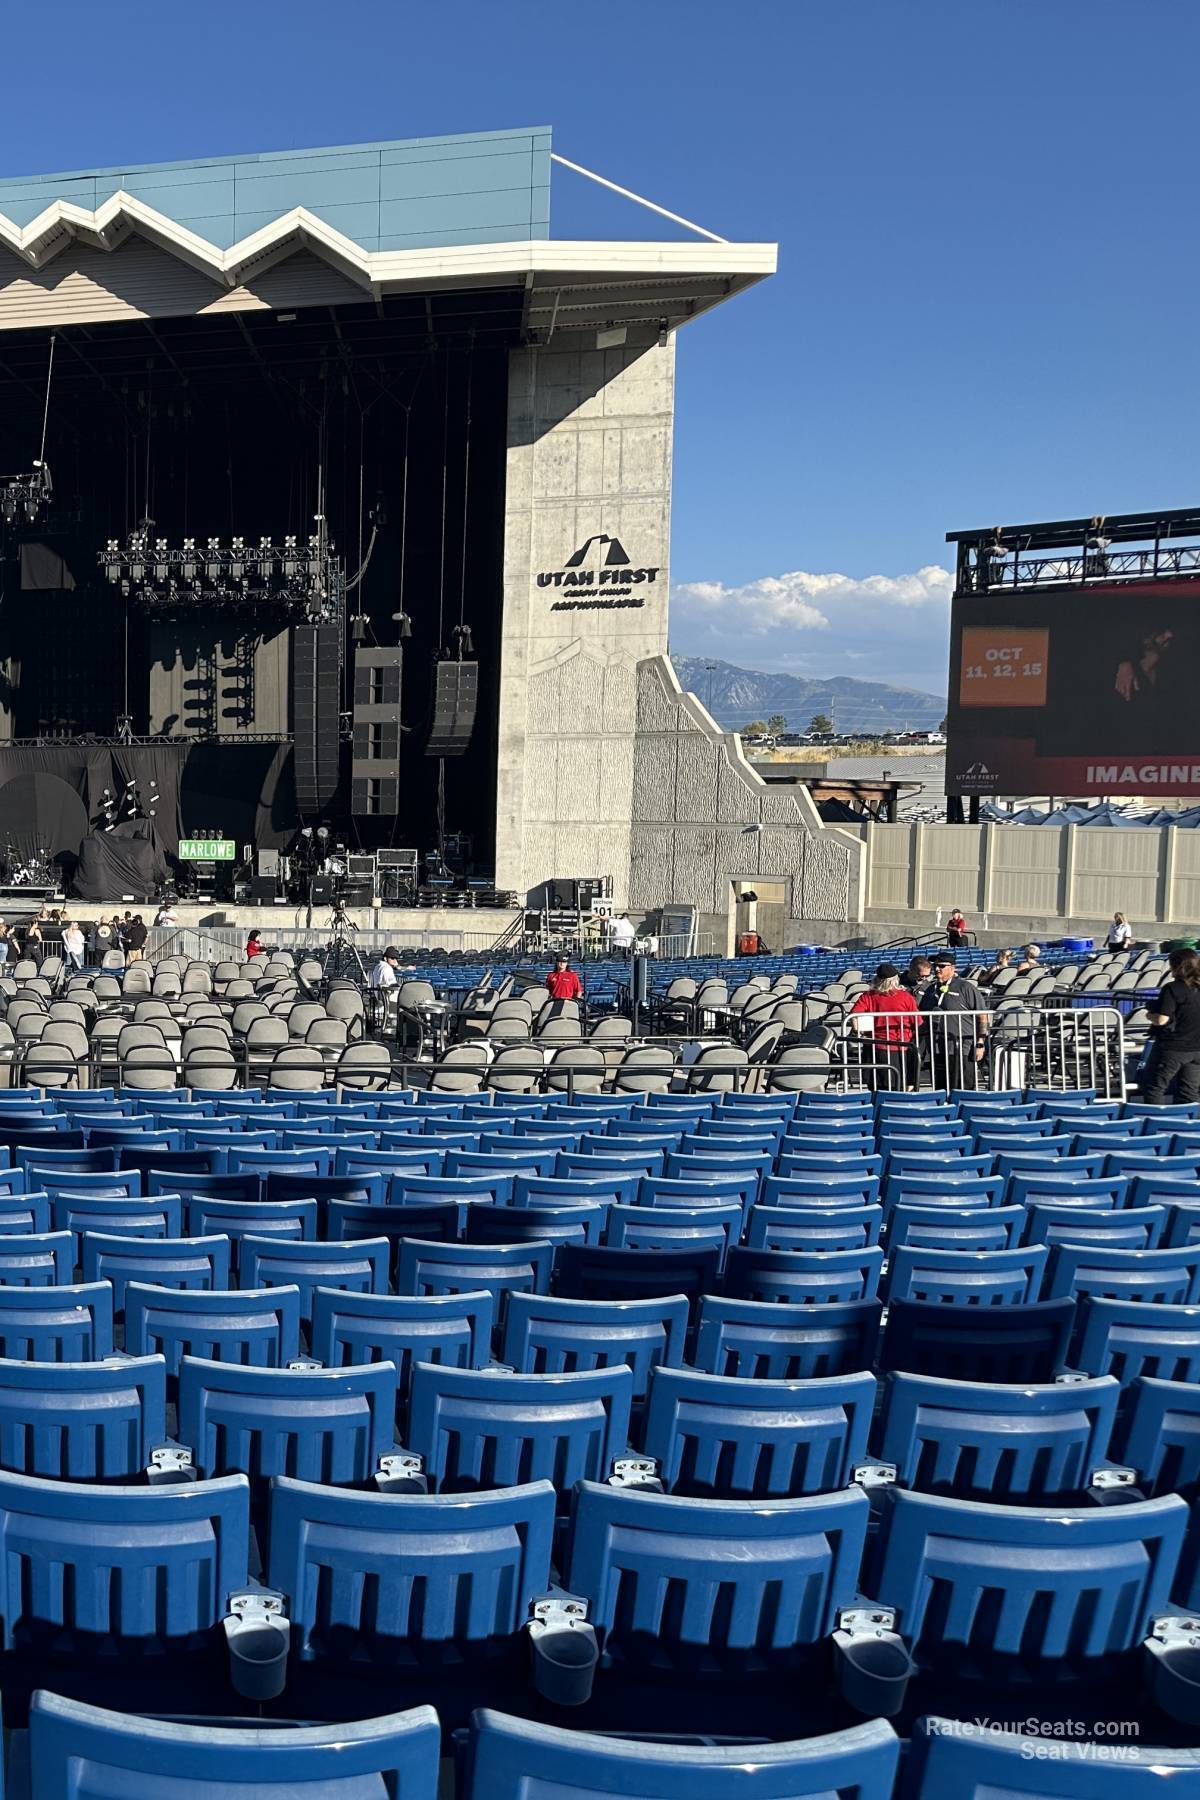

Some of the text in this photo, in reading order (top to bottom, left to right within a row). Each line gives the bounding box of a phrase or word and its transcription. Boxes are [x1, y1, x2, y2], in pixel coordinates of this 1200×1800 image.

[536, 567, 660, 587] UTAH FIRST
[985, 647, 1023, 662] OCT
[965, 663, 1042, 679] 11, 12, 15
[1086, 765, 1200, 783] IMAGINE
[181, 842, 233, 857] MARLOWE
[593, 907, 612, 916] 101
